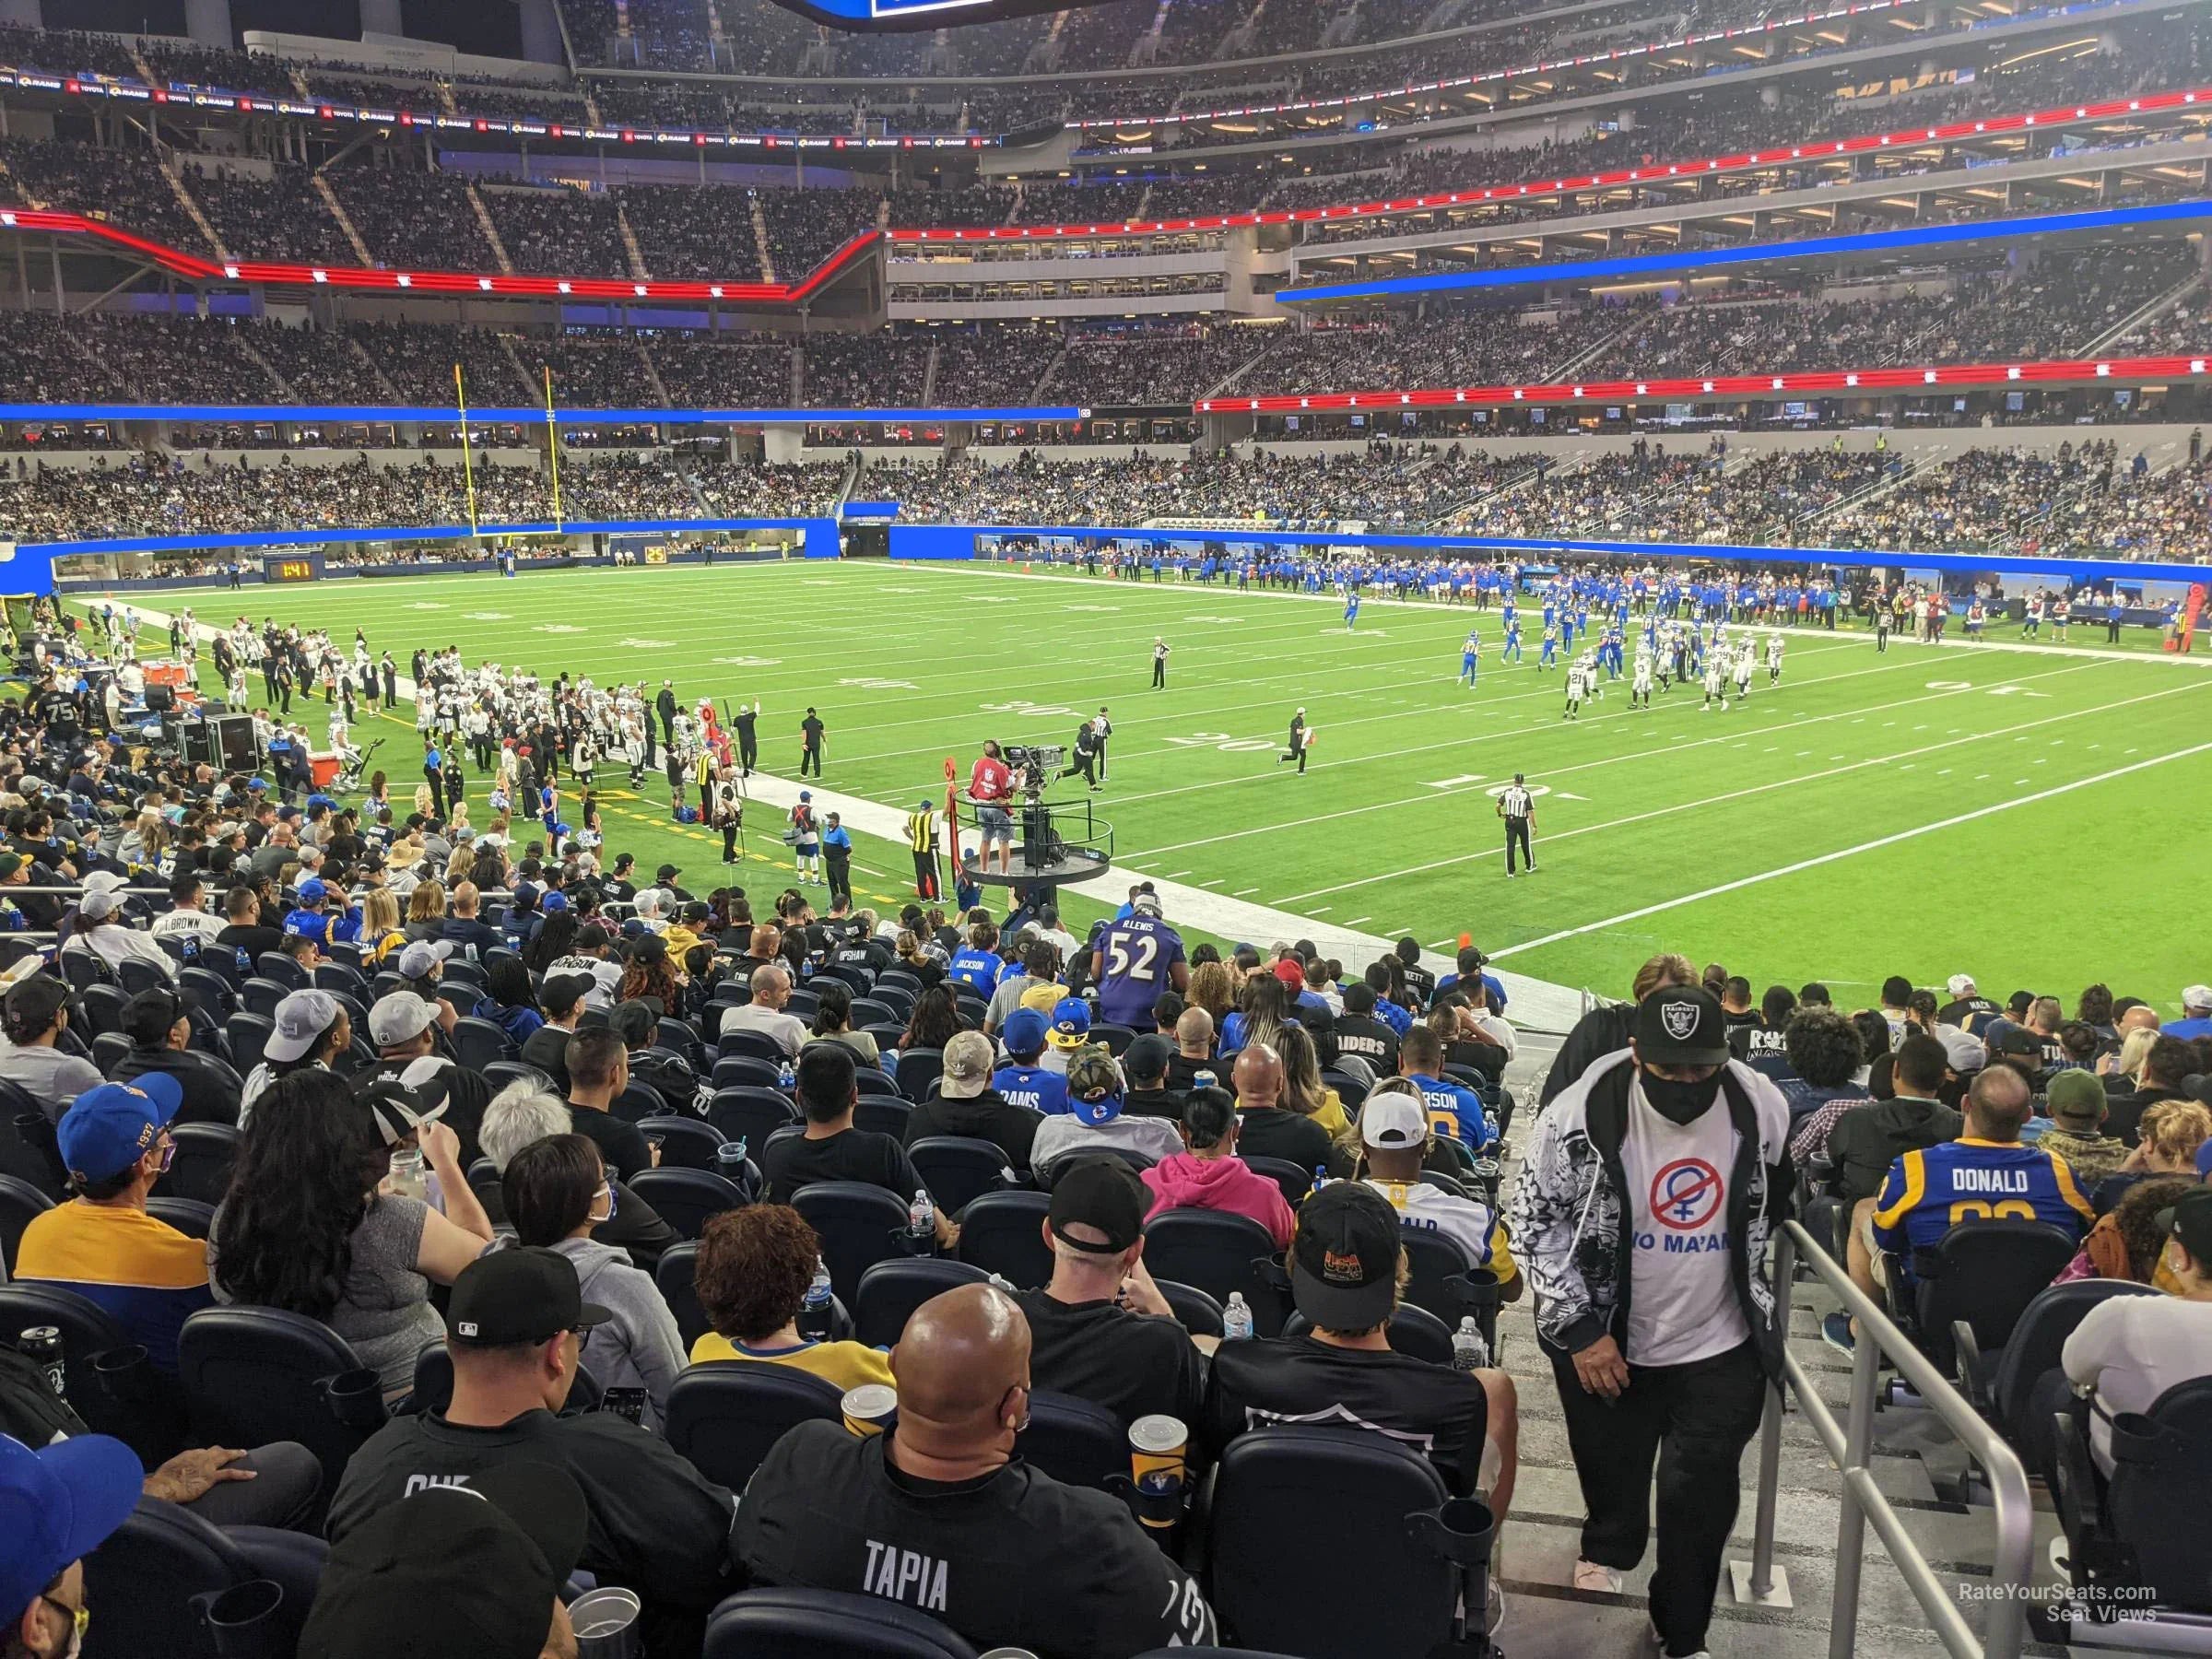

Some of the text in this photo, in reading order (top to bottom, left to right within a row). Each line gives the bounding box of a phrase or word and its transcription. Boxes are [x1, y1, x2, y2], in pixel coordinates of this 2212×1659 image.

[30, 79, 61, 88] RAMS
[121, 89, 149, 98] RAMS
[283, 561, 309, 577] 1:41
[1610, 636, 1621, 644] 72
[1571, 673, 1583, 685] 21
[45, 701, 74, 724] 75
[979, 700, 1071, 717] 30
[1162, 732, 1277, 752] 20
[839, 949, 867, 961] UPSHAW
[1107, 931, 1158, 981] 52
[956, 959, 985, 971] JACKSON
[1405, 970, 1424, 983] KETT
[1337, 1035, 1386, 1056] AIDERS
[1423, 1091, 1458, 1111] RSON
[1952, 1168, 2029, 1193] DONALD
[863, 1538, 948, 1612] TAPIA
